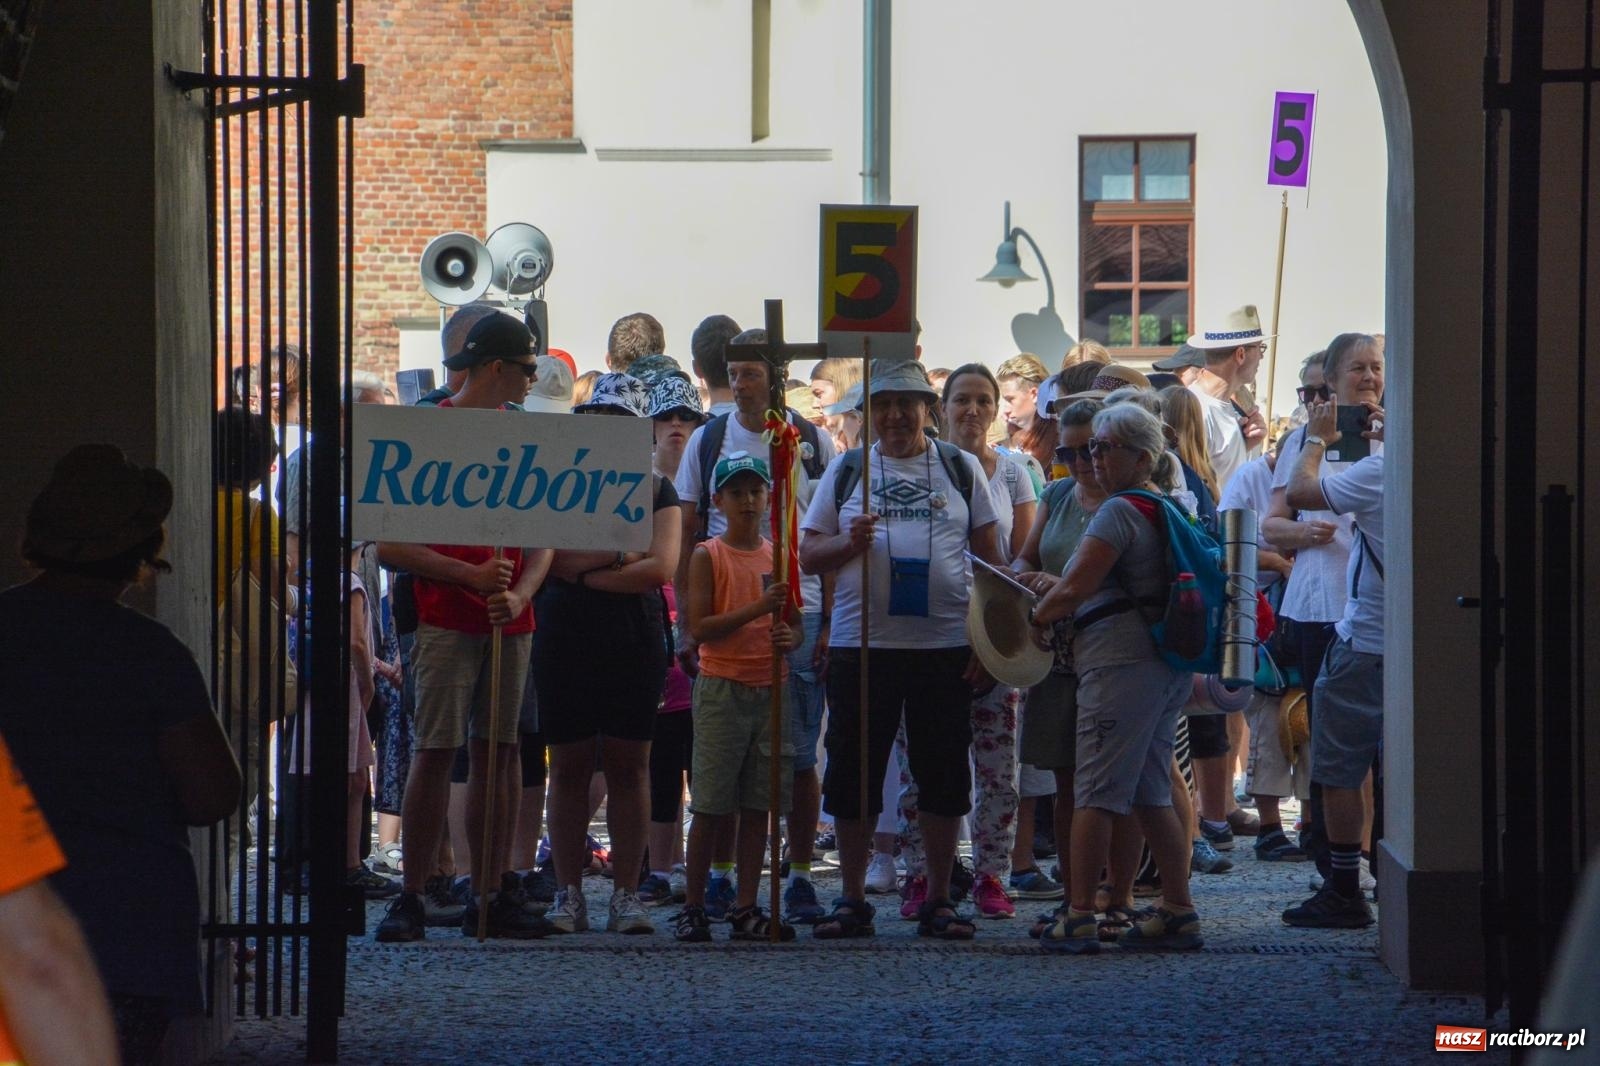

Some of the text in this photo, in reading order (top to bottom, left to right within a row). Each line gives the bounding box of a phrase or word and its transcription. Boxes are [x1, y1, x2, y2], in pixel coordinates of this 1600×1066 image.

[1275, 102, 1306, 176] 5
[835, 222, 899, 320] 5
[359, 440, 645, 522] Racibórz
[878, 506, 931, 518] umbro
